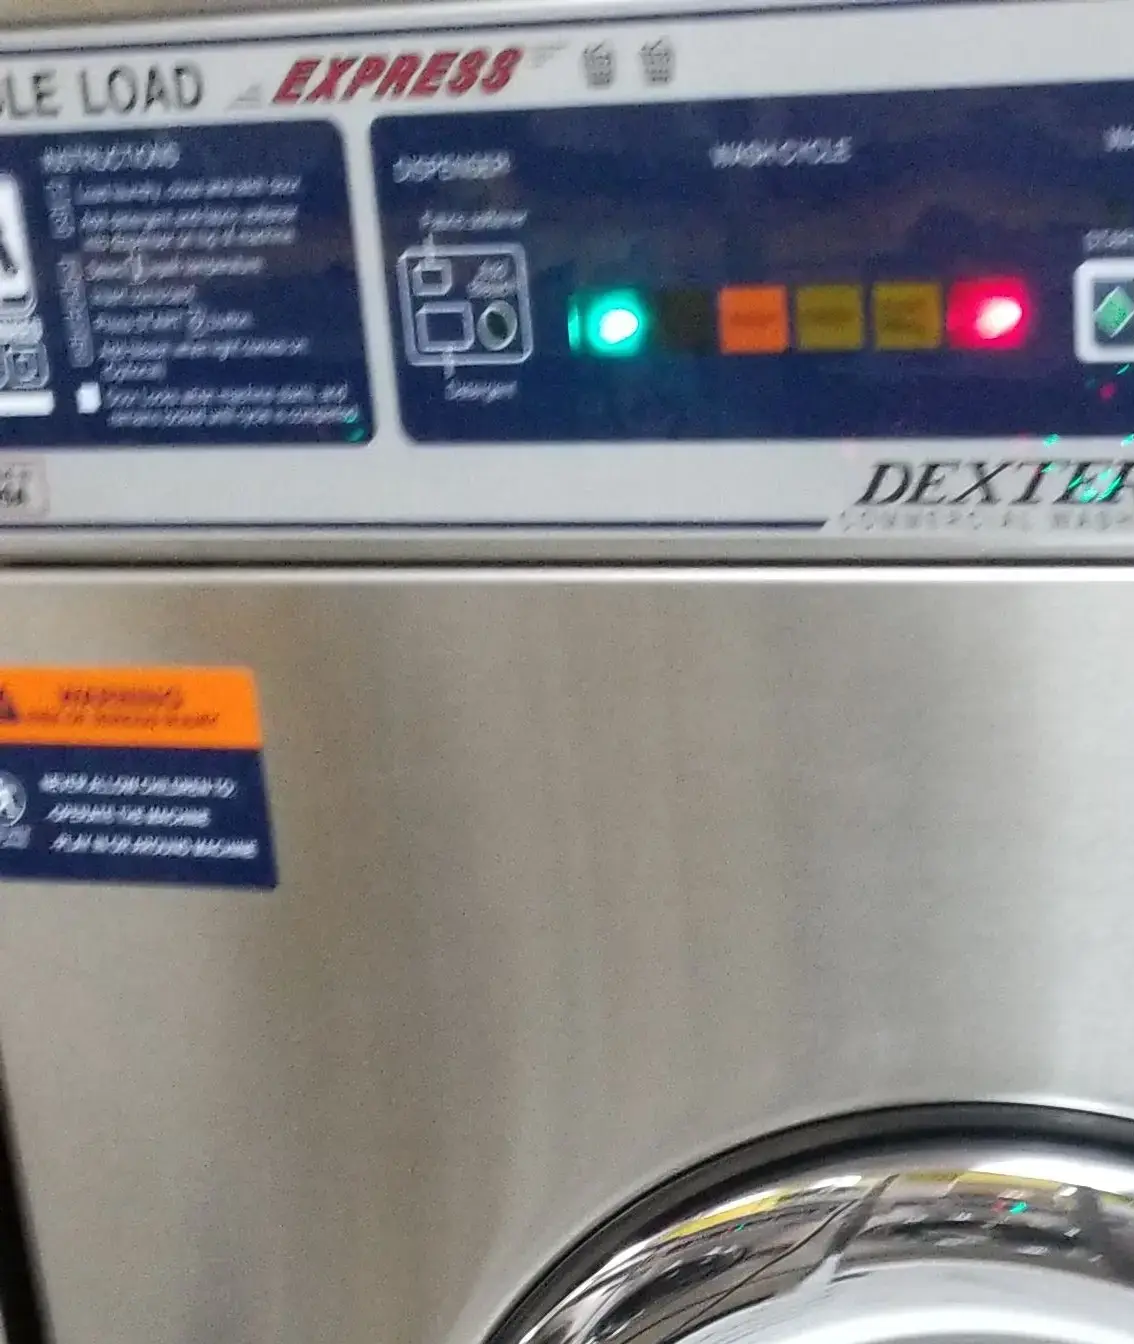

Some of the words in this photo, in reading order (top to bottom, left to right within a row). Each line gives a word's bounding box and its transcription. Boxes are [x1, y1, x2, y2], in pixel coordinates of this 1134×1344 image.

[0, 68, 62, 119] LE
[78, 62, 205, 116] LOAD
[272, 47, 525, 104] EXPRESS
